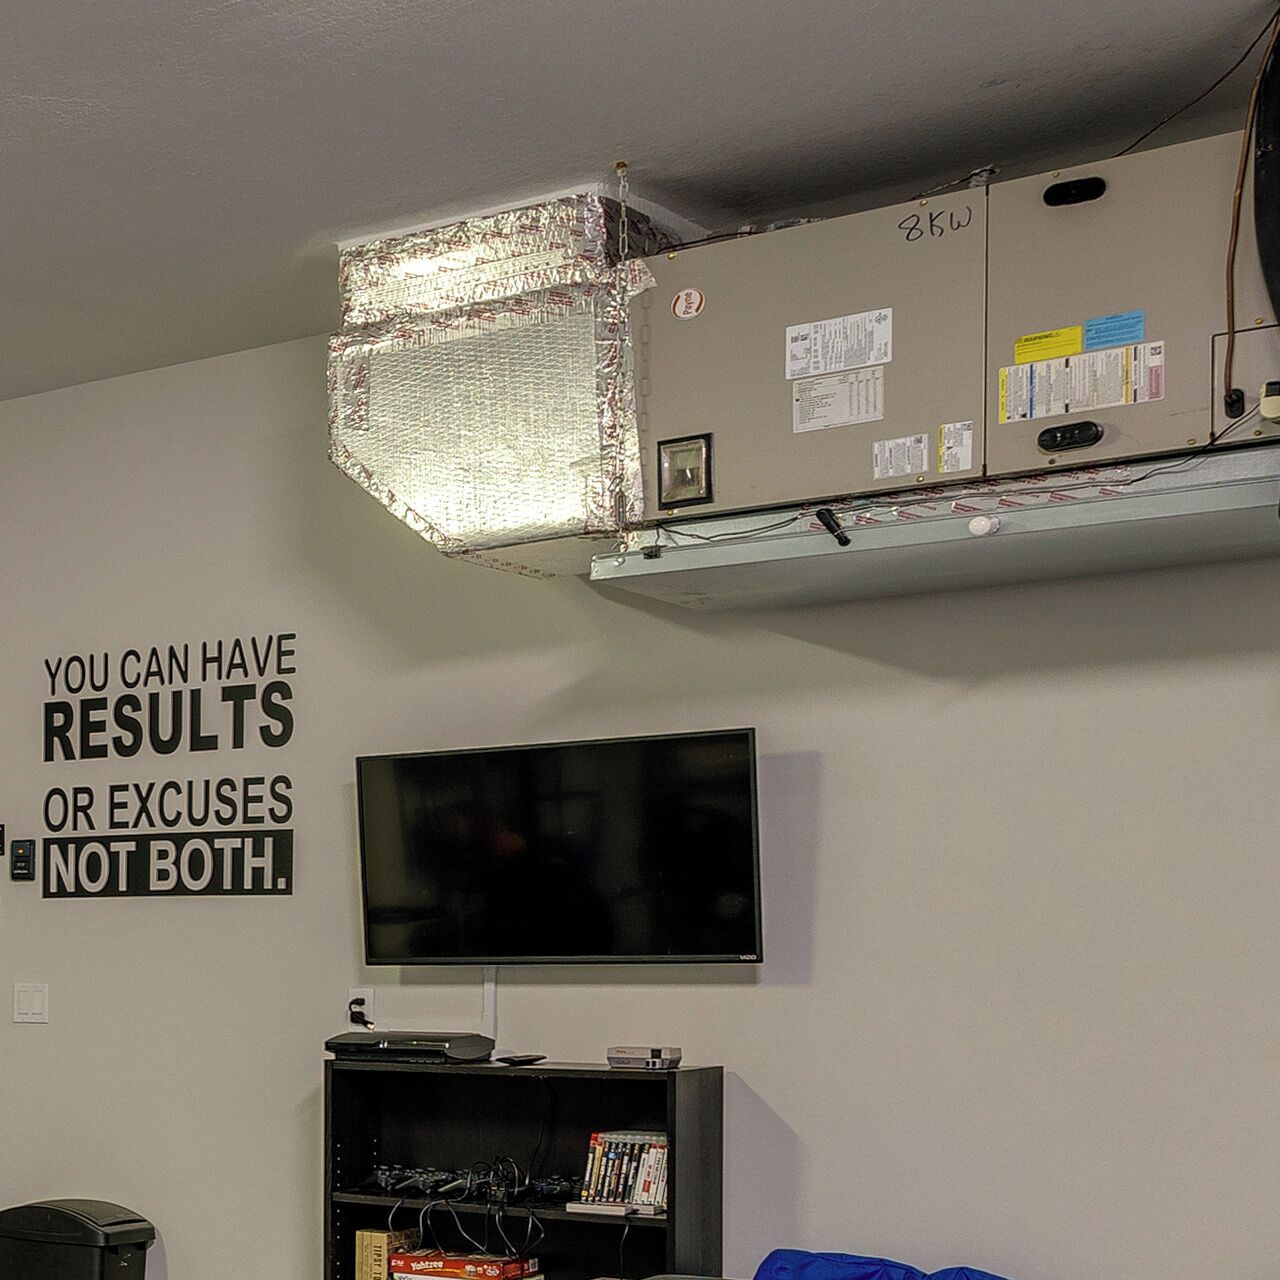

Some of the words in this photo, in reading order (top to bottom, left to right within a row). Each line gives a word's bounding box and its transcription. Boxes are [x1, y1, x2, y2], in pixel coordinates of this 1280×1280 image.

[44, 652, 109, 696] YOU
[121, 643, 189, 688] CAN
[202, 633, 296, 682] HAVE
[43, 680, 295, 762] RESULTS
[43, 786, 96, 833] OR
[109, 775, 293, 830] EXCUSES
[49, 840, 137, 894] NOT
[149, 837, 287, 892] BOTH.
